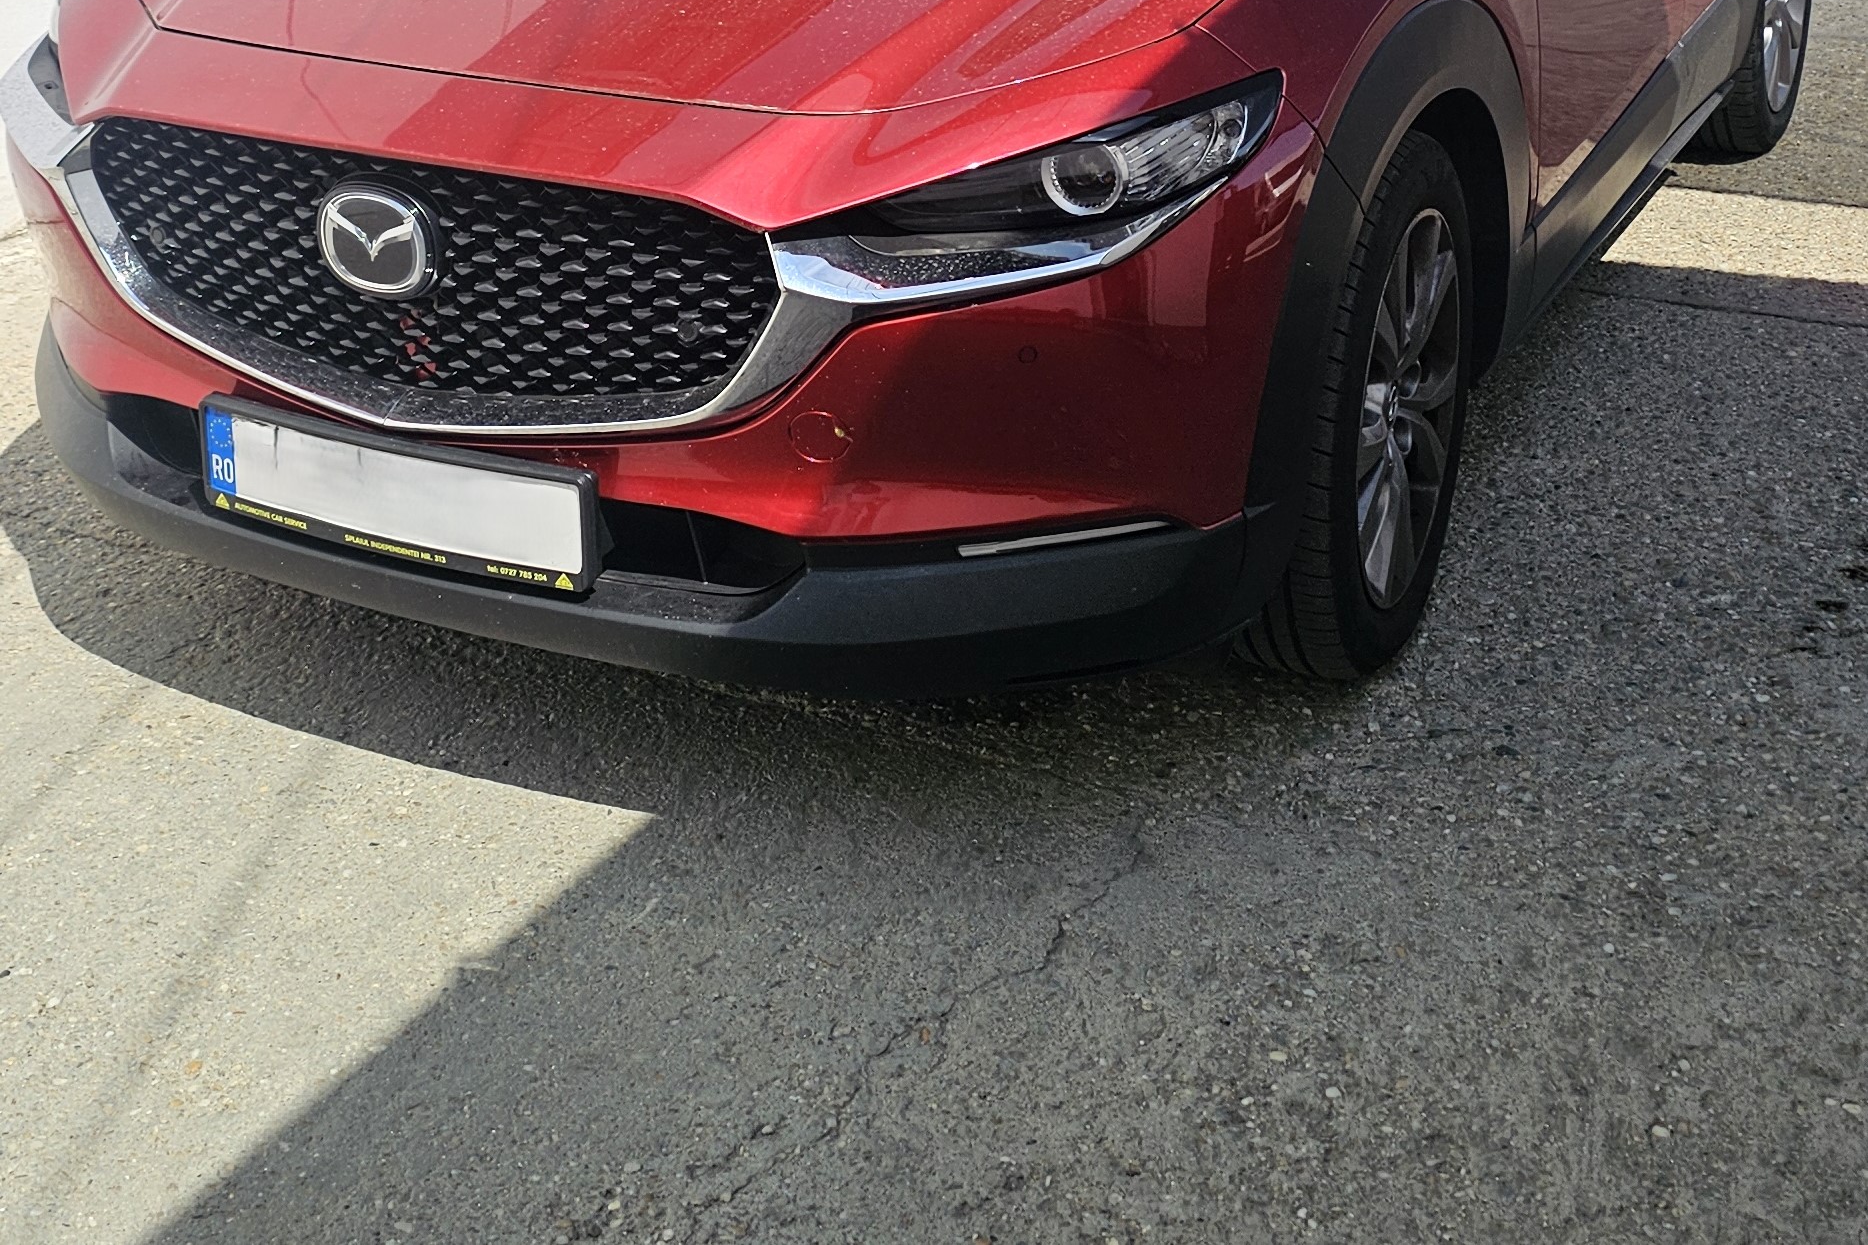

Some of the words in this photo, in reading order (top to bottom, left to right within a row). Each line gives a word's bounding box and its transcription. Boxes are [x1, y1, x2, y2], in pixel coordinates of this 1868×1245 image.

[212, 454, 234, 483] RO
[271, 514, 283, 523] CAR
[284, 517, 308, 530] SERVICE
